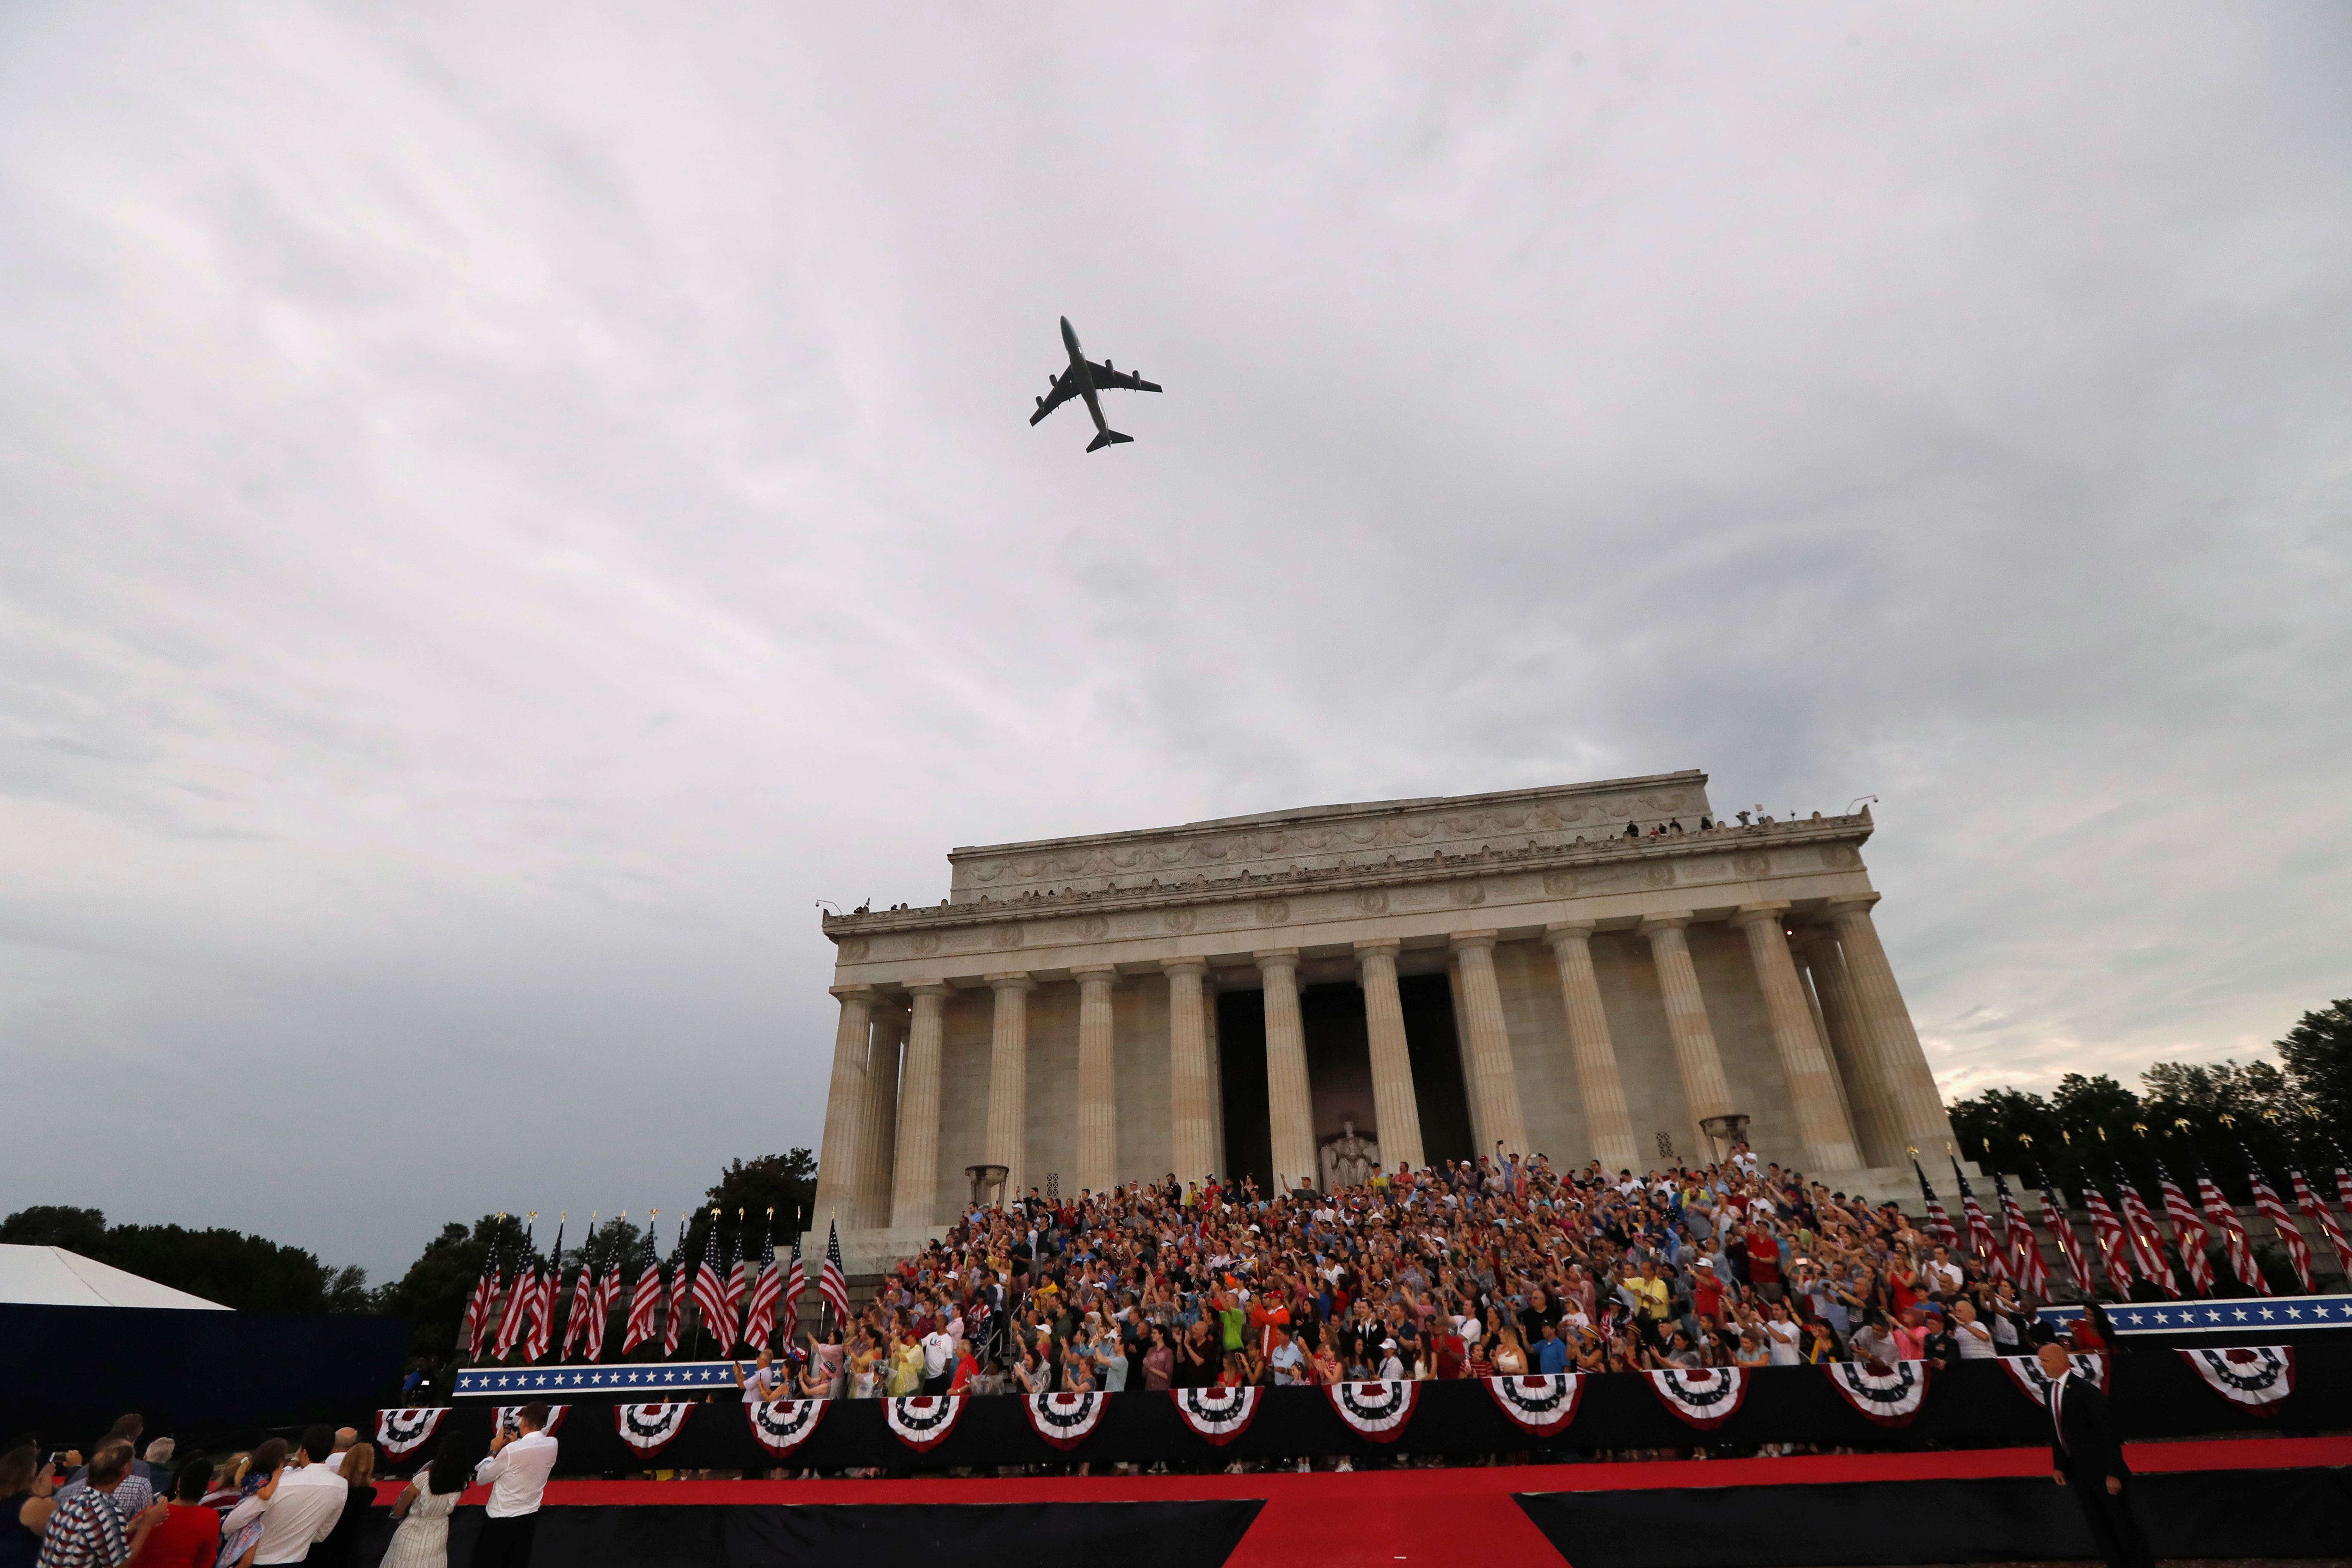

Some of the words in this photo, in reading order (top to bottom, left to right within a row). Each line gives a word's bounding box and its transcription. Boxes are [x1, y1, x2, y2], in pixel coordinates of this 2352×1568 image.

[1439, 842, 1476, 851] VIRGINIA
[1166, 868, 1212, 878] WISCONSIN
[1220, 864, 1268, 873] CALIFORNIA
[1058, 881, 1089, 890] FLORIDA
[1100, 877, 1124, 885] TEXAS
[1011, 885, 1049, 894] MICHIGAN
[1117, 918, 1159, 928] GEORGIA
